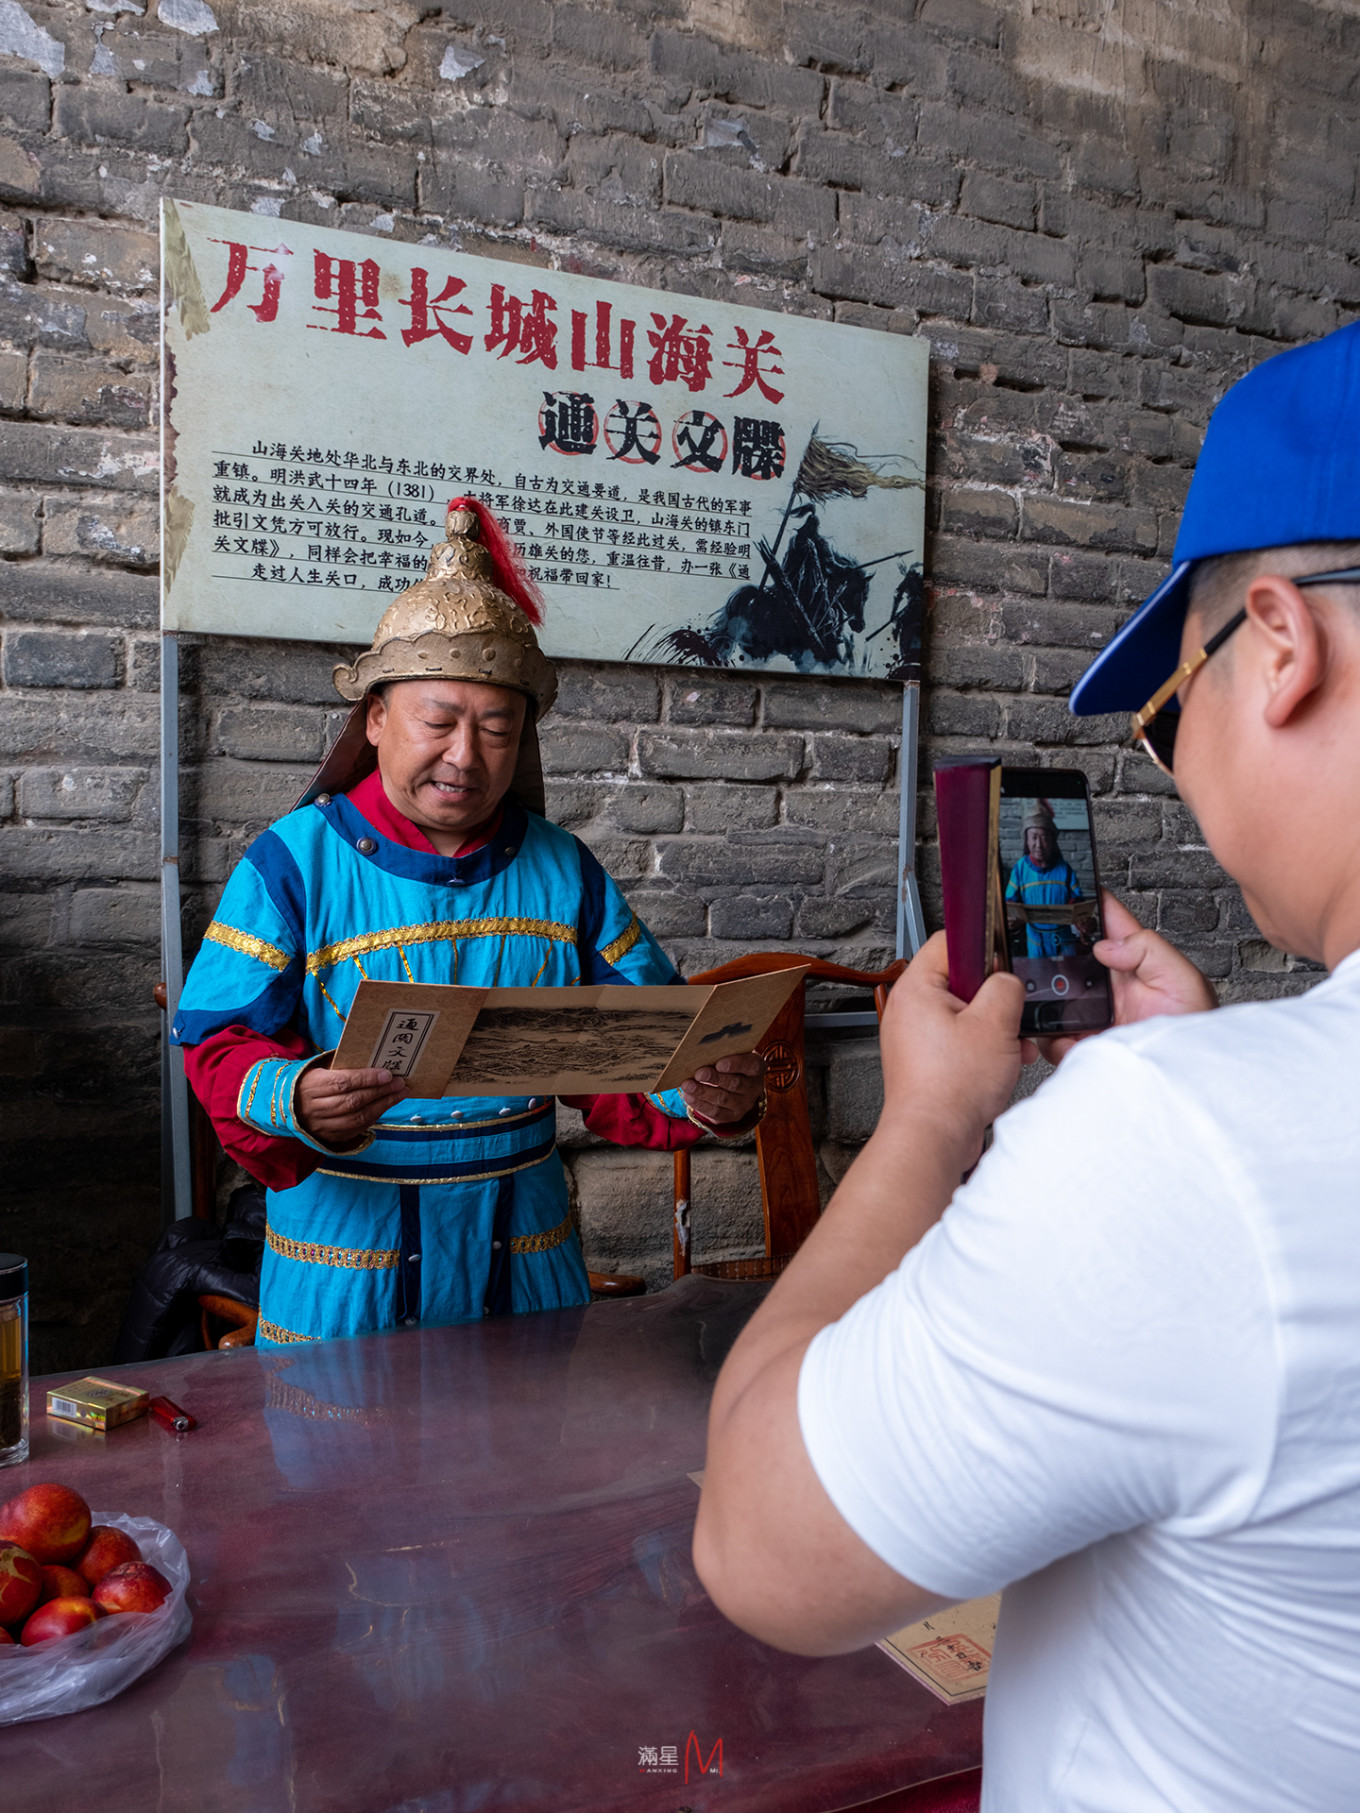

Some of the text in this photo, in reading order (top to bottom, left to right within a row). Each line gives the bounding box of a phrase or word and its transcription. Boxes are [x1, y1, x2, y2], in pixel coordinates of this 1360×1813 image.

[207, 237, 785, 404] 万里长城山海关
[539, 390, 785, 480] 通关文牒
